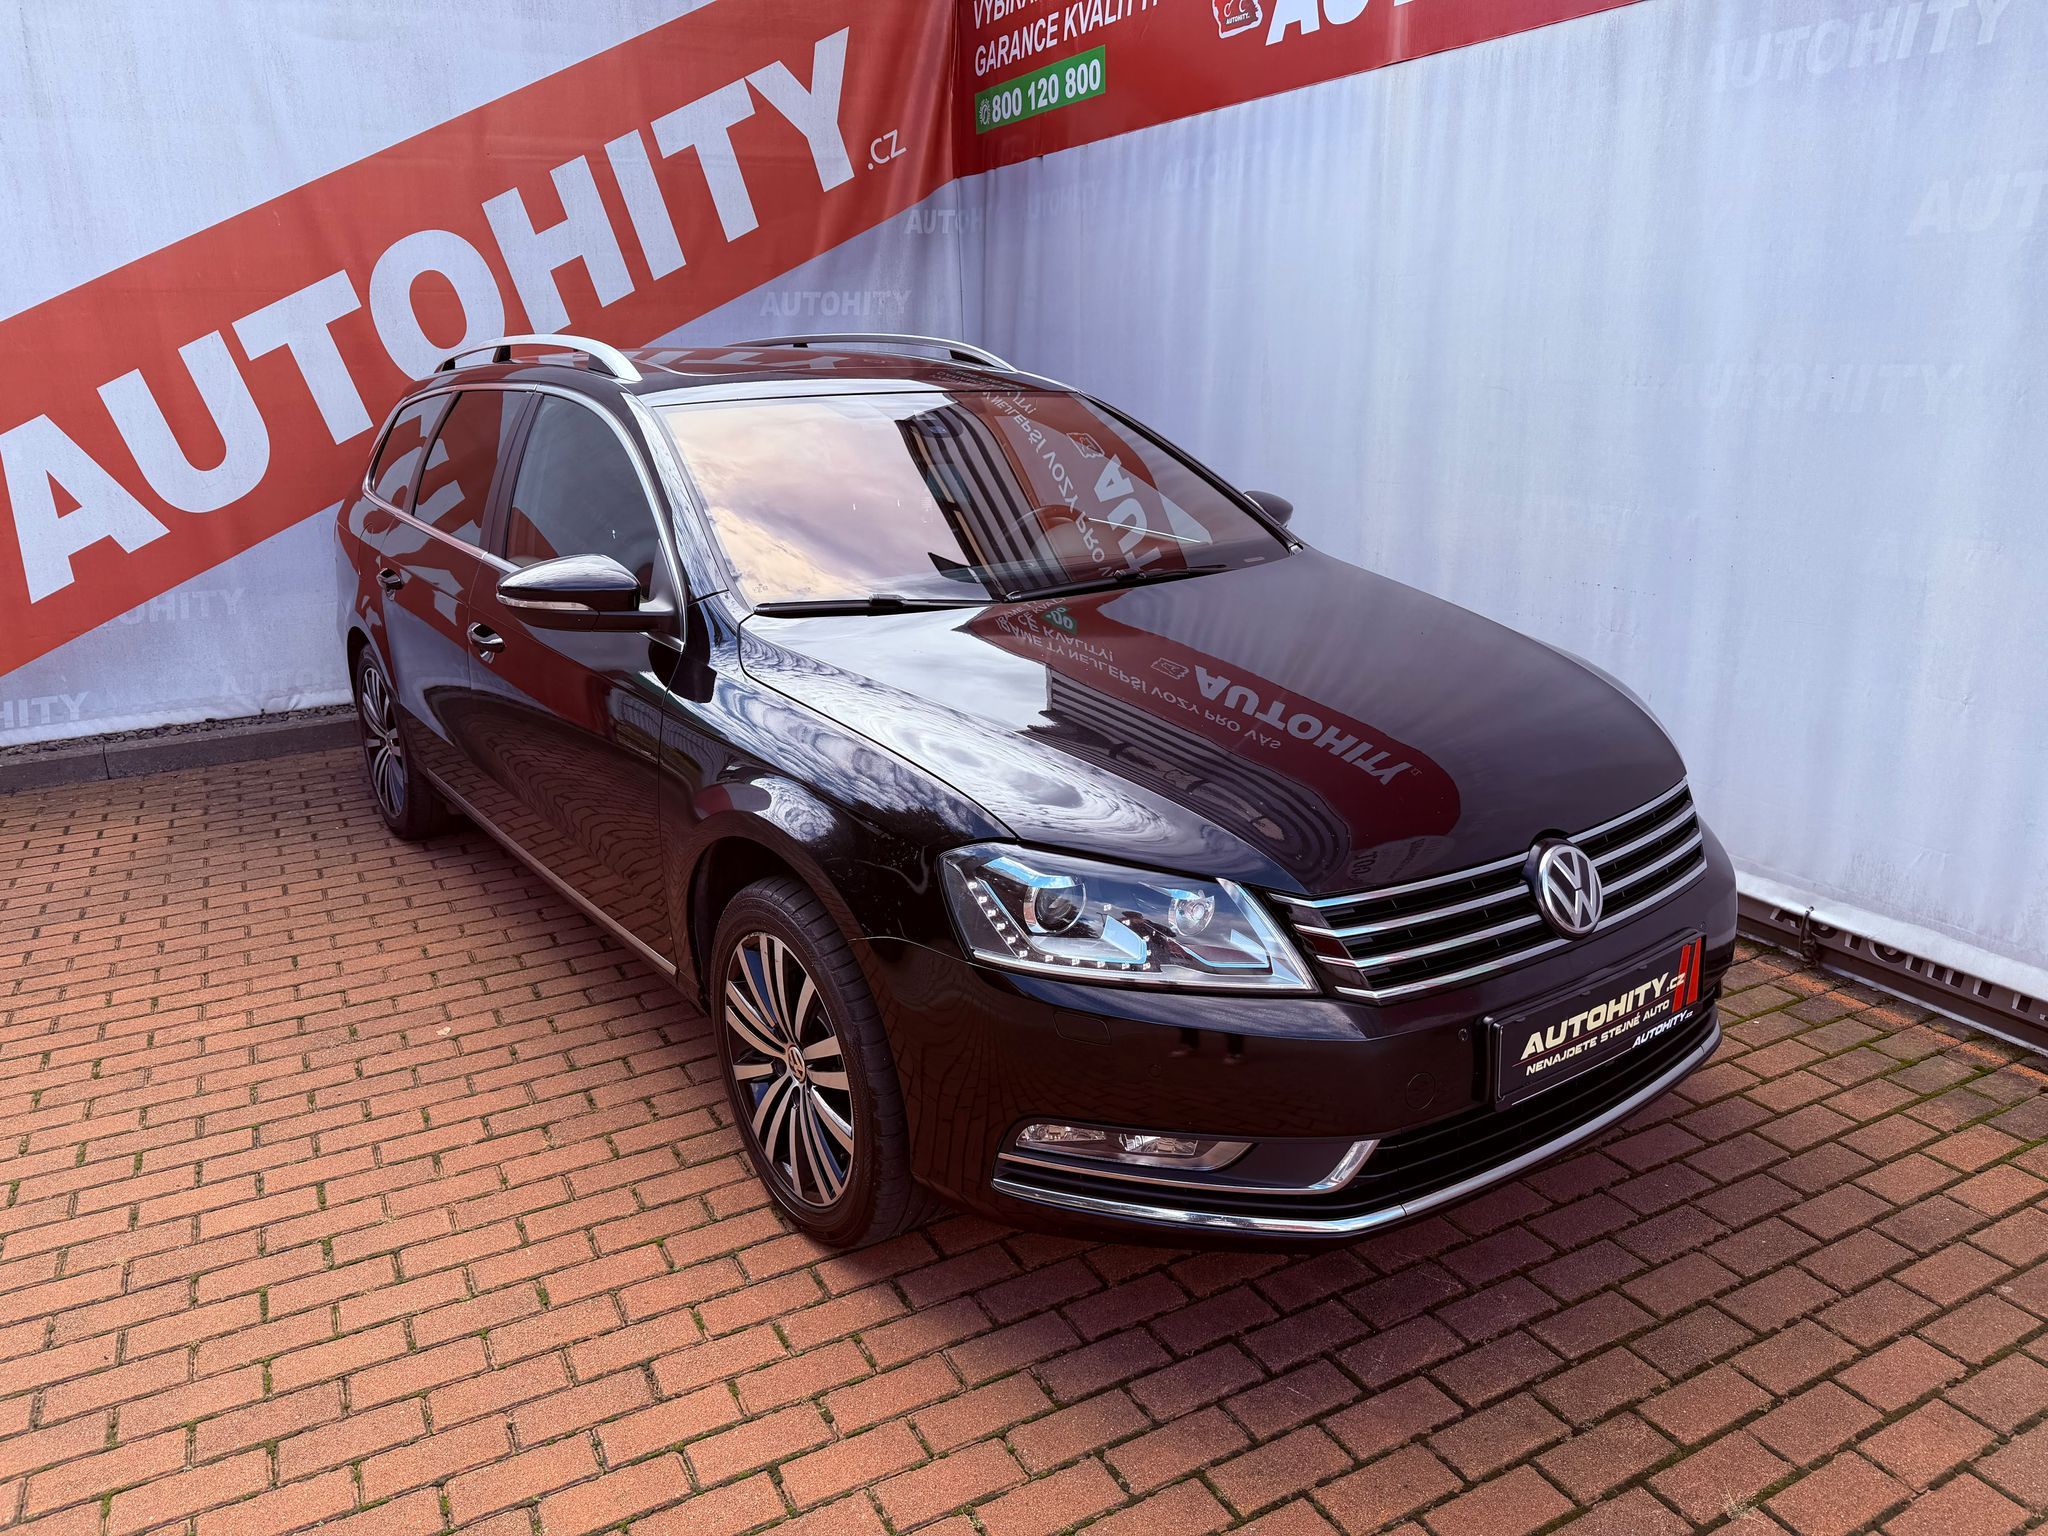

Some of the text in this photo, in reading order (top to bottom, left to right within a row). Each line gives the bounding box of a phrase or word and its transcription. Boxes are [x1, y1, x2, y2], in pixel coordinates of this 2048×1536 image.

[975, 11, 1060, 77] GARANCE
[991, 58, 1101, 123] 800 120 800
[1525, 999, 1671, 1077] NENAJDETE STEJNÉ AUTO
